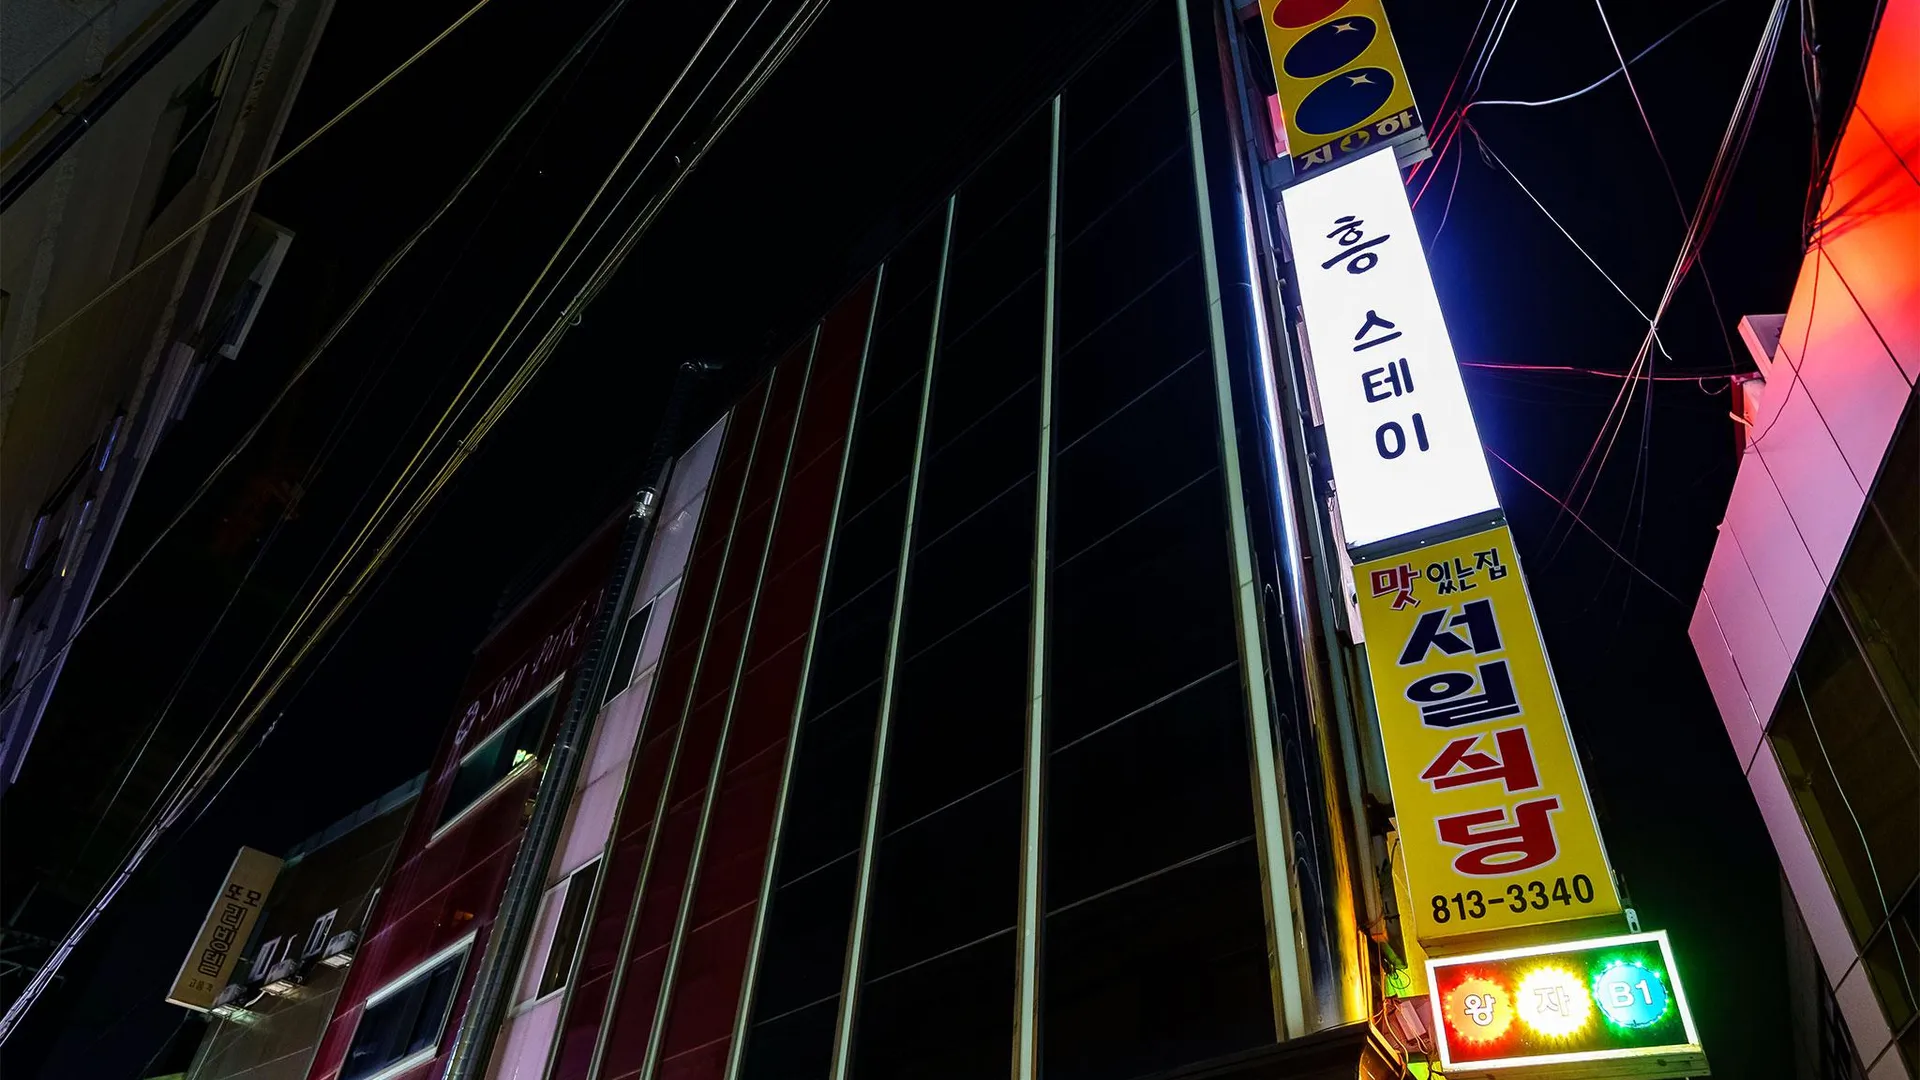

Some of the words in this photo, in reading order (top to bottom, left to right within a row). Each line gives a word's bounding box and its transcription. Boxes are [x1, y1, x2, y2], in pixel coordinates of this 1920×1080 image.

[1321, 215, 1390, 275] 흥
[1353, 310, 1430, 460] 스테이
[1431, 874, 1595, 924] 813-3340
[1608, 979, 1653, 1009] B1
